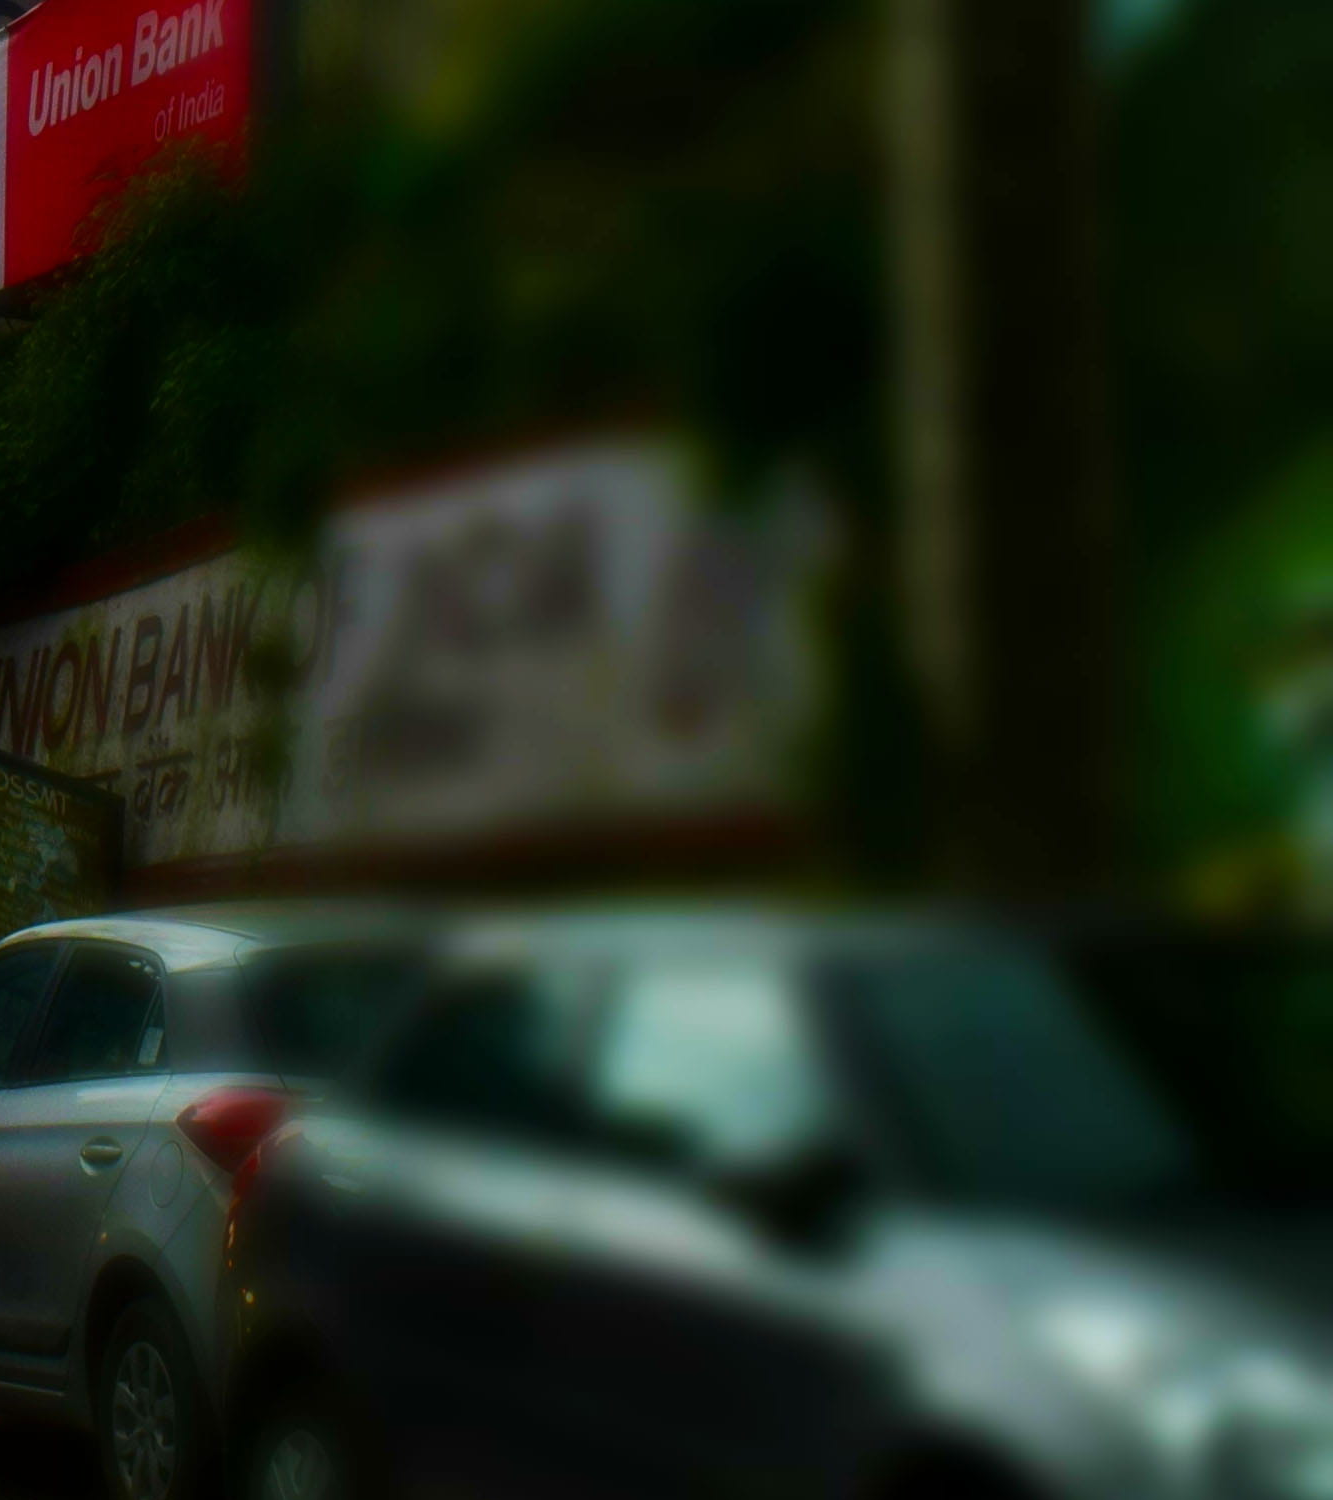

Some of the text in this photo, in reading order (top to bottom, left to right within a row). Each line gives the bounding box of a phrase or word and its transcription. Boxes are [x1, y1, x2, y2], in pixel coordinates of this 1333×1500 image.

[28, 43, 124, 138] Union
[154, 76, 226, 142] of India
